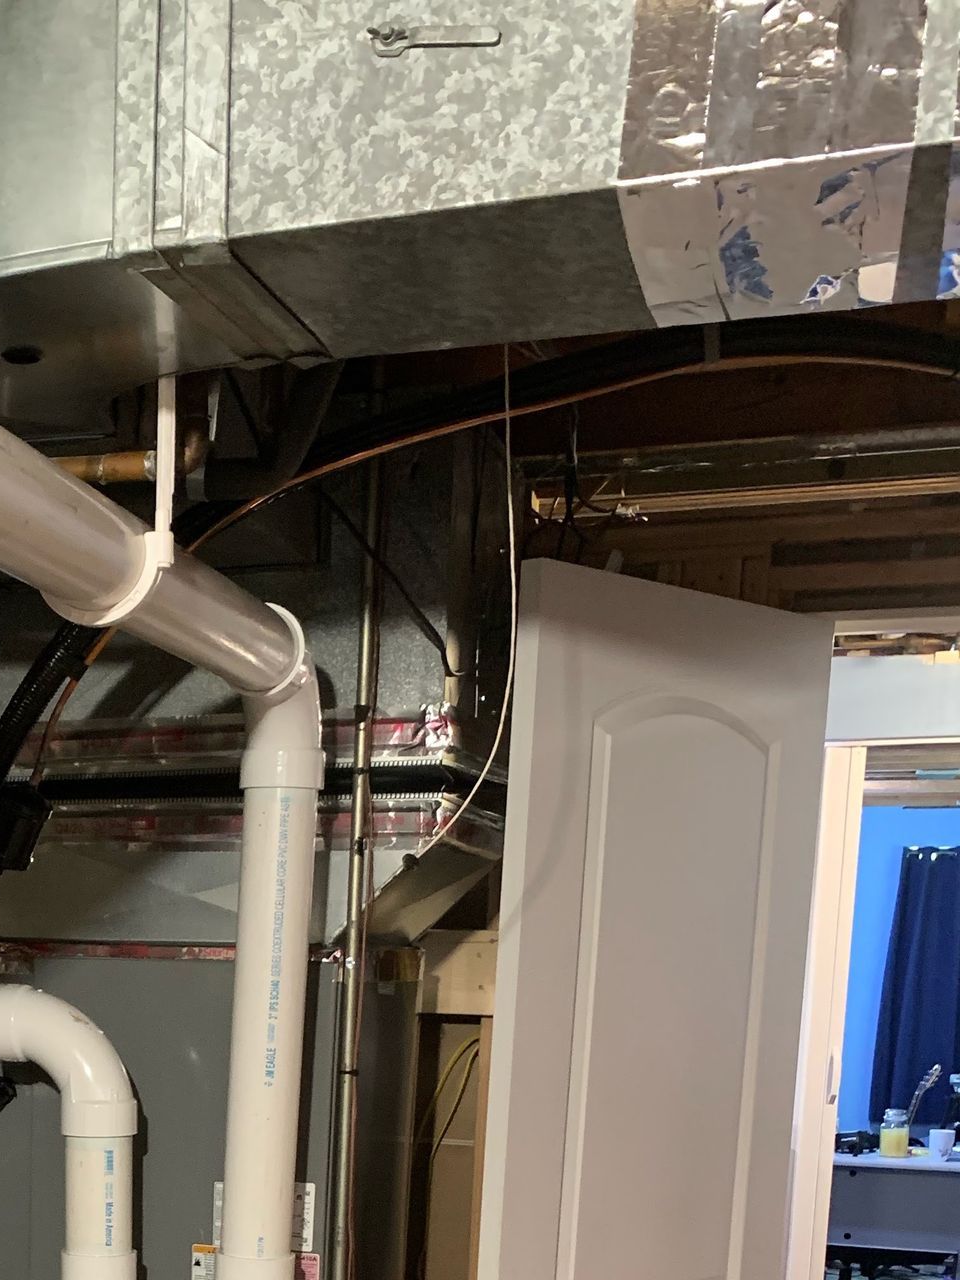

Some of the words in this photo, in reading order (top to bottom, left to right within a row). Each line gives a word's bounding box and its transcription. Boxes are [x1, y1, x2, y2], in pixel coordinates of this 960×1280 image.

[277, 856, 288, 877] CORE
[275, 878, 286, 910] CELLULAR
[266, 1047, 276, 1069] EAGLE
[265, 1069, 275, 1079] JM
[105, 1202, 114, 1216] Made
